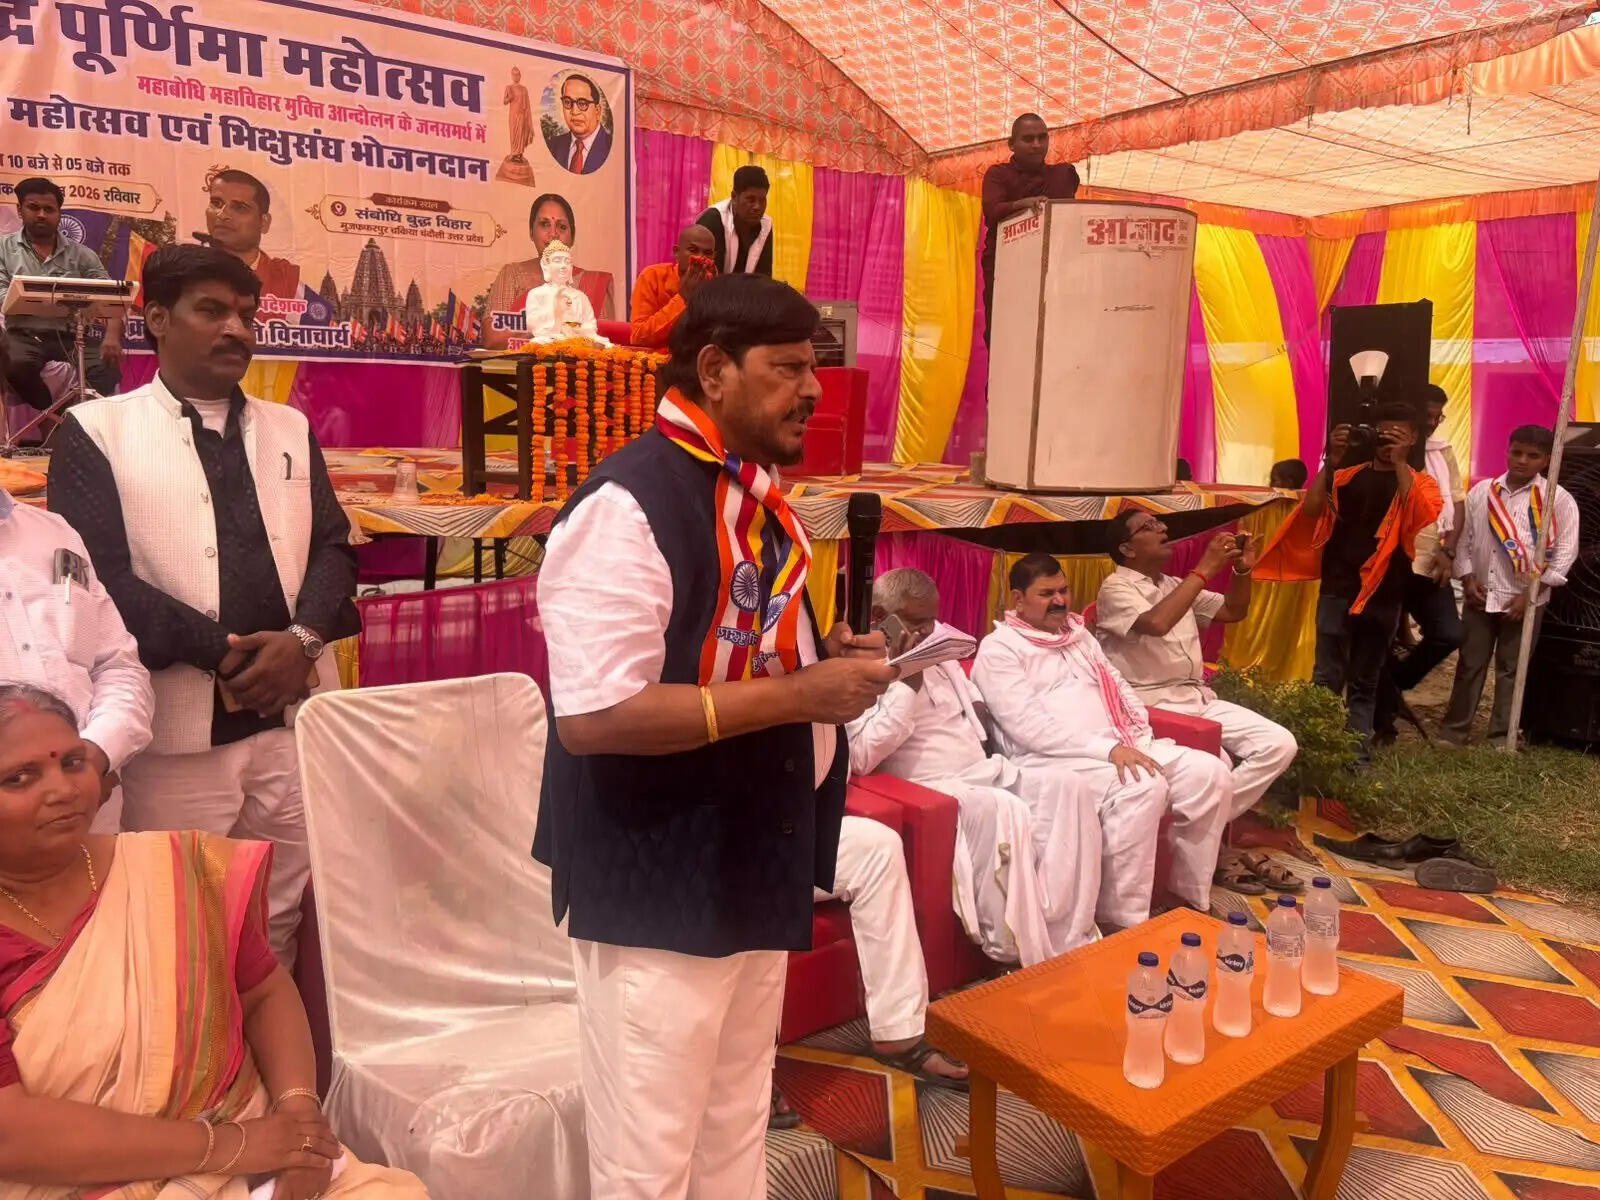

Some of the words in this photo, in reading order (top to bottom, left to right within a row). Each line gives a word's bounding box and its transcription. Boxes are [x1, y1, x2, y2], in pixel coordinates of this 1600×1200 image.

[55, 0, 267, 77] पूर्णिमा
[279, 36, 484, 113] महोत्सव
[137, 75, 206, 101] महाबोधि
[209, 86, 281, 112] महाविहार
[284, 95, 324, 120] मुक्ति
[328, 104, 395, 129] आन्दोलन
[396, 112, 413, 131] के
[474, 124, 487, 143] में
[7, 94, 150, 138] महोत्सव
[158, 113, 212, 145] एवं
[219, 115, 346, 165] भिक्षुसंघ
[351, 135, 489, 181] भोजनदान
[7, 154, 24, 169] 10
[27, 153, 49, 170] बजे
[52, 154, 63, 170] से
[66, 157, 82, 171] 05
[86, 157, 105, 175] बजे
[108, 162, 132, 176] तक
[70, 185, 100, 200] 2026
[104, 187, 141, 204] रविवार
[354, 208, 402, 223] संबोधि
[406, 213, 432, 228] बुद्ध
[436, 216, 472, 231] विहार
[390, 225, 418, 237] चकिया
[1002, 216, 1040, 240] आजाद
[1086, 217, 1178, 246] आजाद
[267, 321, 352, 346] विनाचार्य
